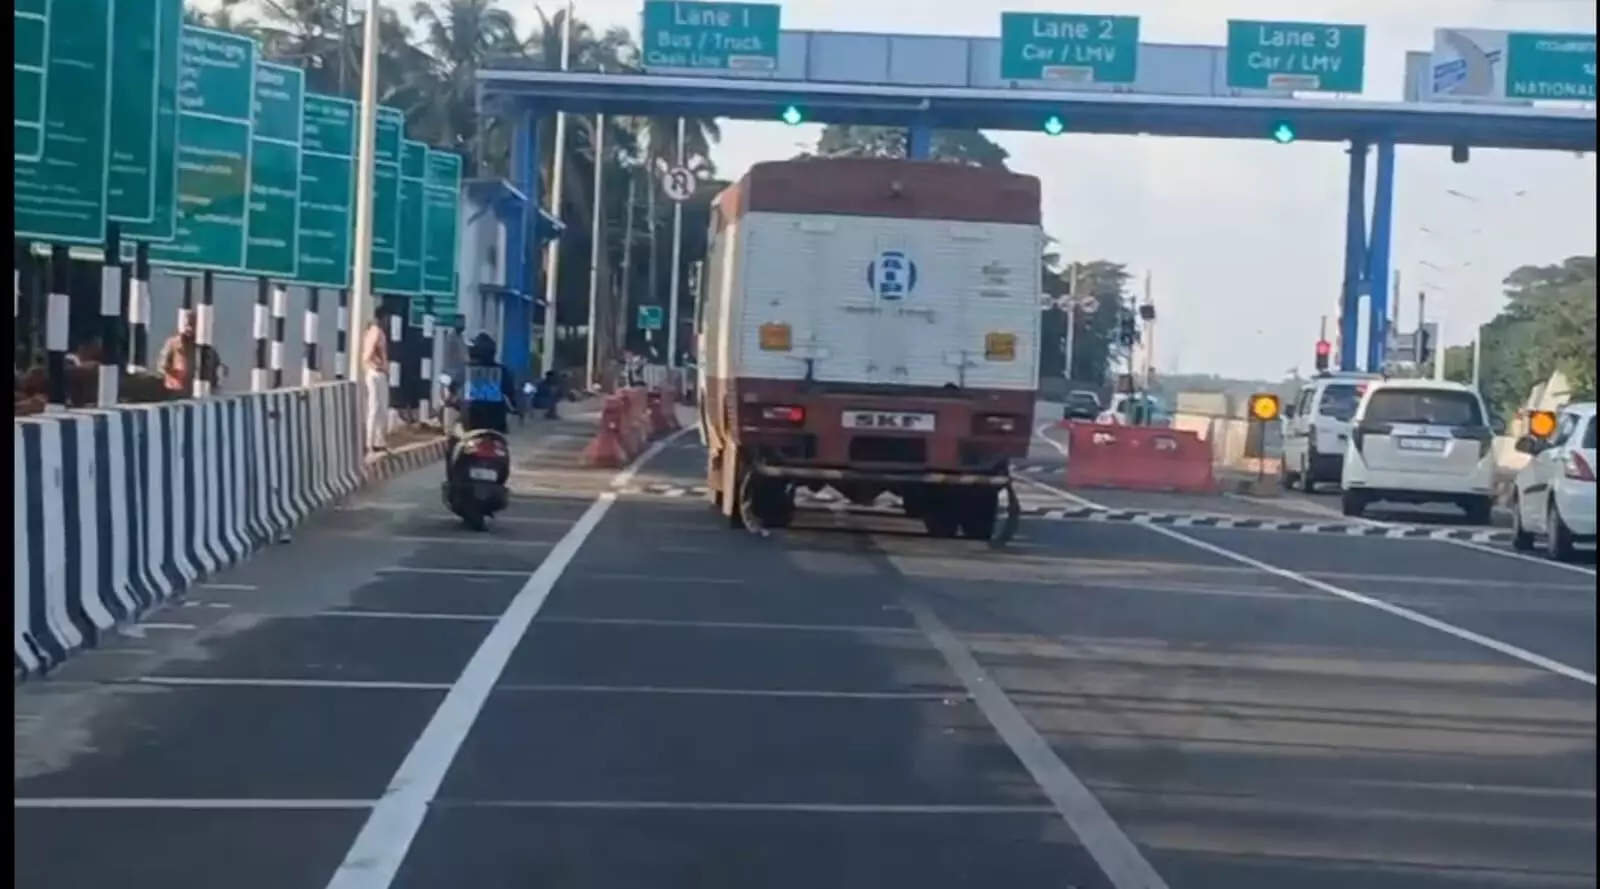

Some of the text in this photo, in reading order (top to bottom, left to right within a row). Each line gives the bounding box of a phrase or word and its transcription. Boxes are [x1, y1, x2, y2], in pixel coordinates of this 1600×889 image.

[675, 3, 749, 27] Lane 1
[1032, 17, 1114, 40] Lane 2
[1259, 25, 1340, 48] Lane 3
[657, 31, 763, 50] Bus / Truck
[1022, 43, 1116, 62] Car / LMV
[1247, 51, 1341, 72] Car / LMV
[1514, 81, 1596, 97] NATIONAL
